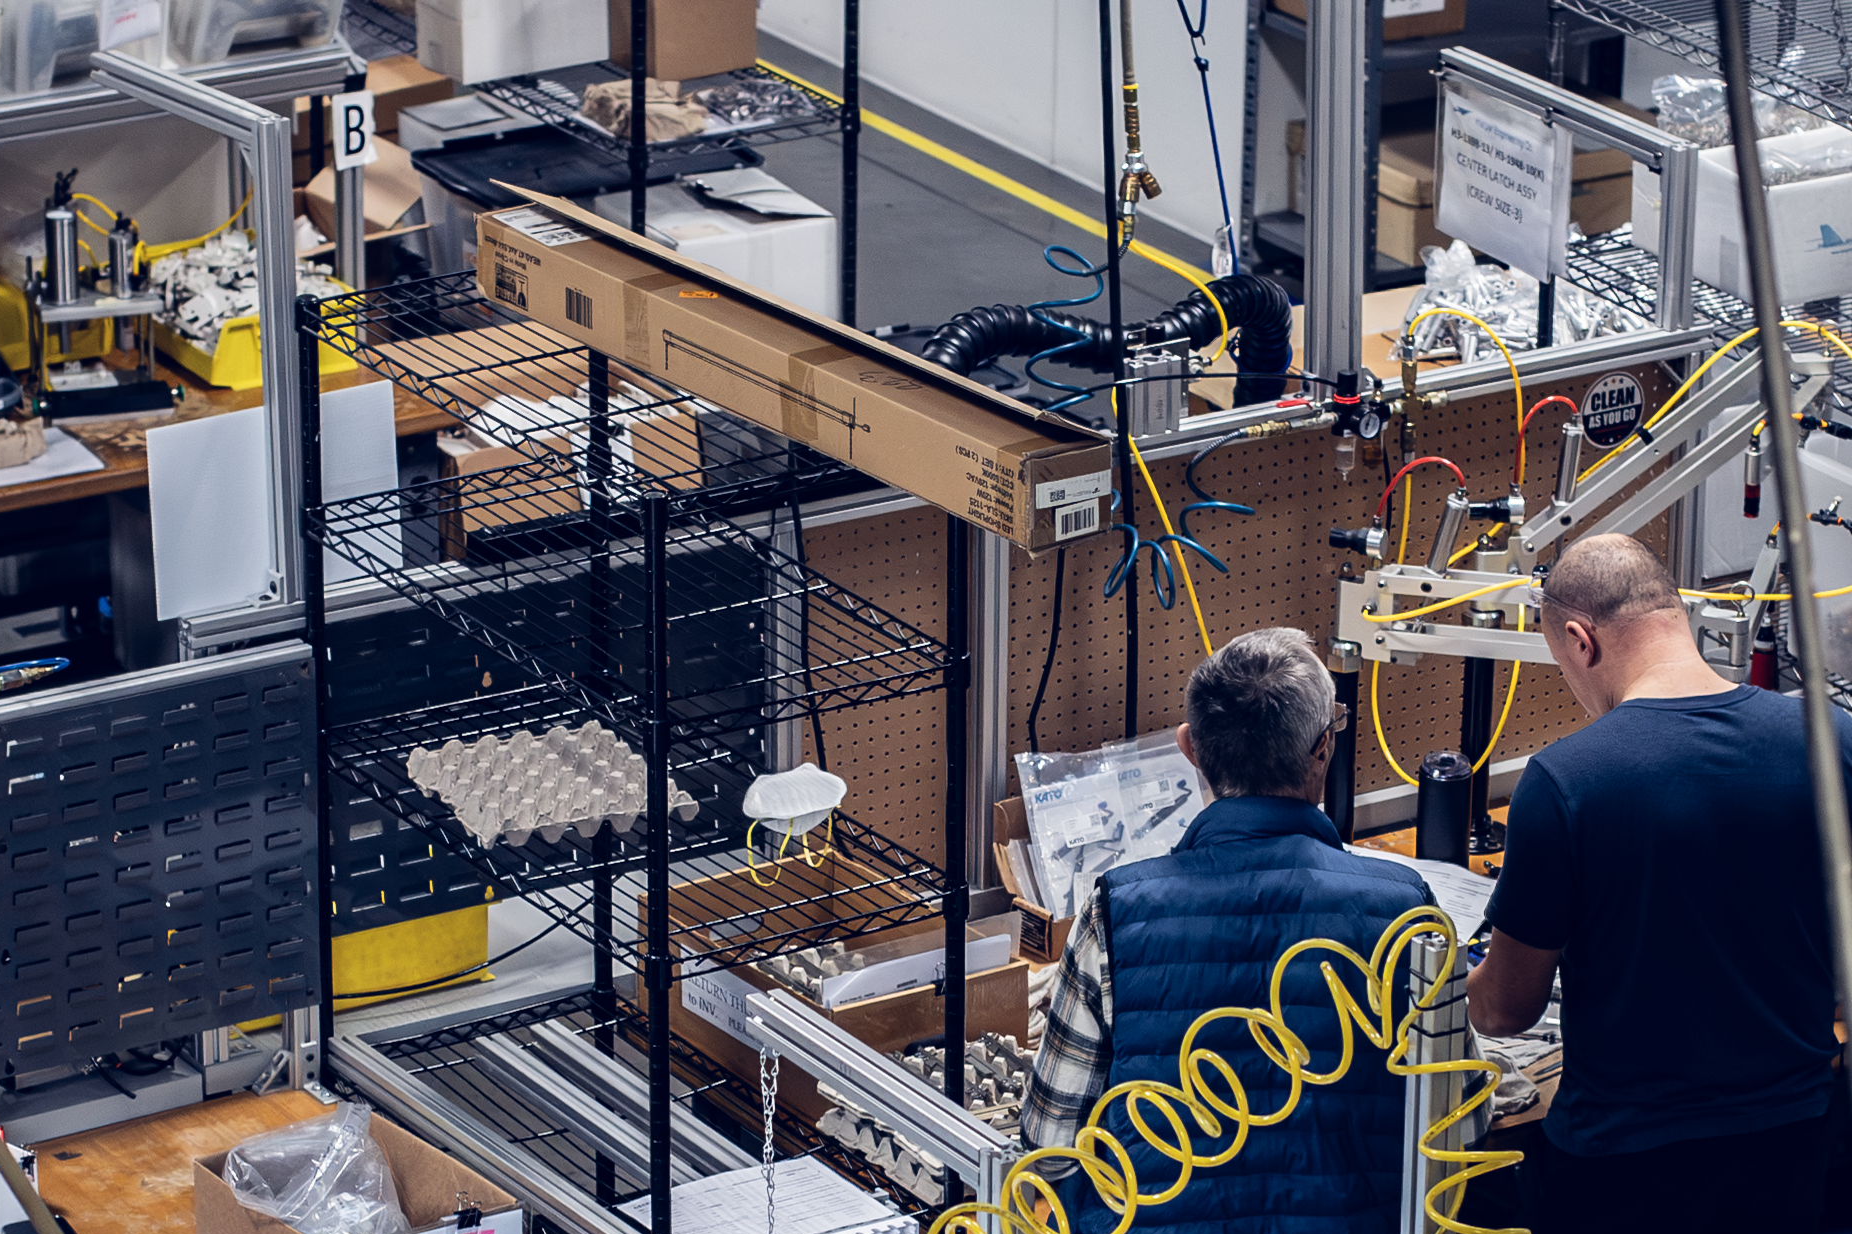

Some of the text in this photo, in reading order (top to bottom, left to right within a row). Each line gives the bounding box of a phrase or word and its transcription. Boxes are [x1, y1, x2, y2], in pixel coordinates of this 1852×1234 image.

[344, 104, 366, 156] B
[1456, 152, 1537, 201] CENTER LATCH ASSY
[1591, 385, 1635, 412] CLEAN
[1589, 408, 1636, 429] AS YOU GO
[969, 506, 1014, 536] LED SHOPLIGHT
[1035, 789, 1063, 804] KATO
[1069, 837, 1085, 846] KATO
[688, 991, 699, 1007] to
[729, 989, 753, 1017] THI
